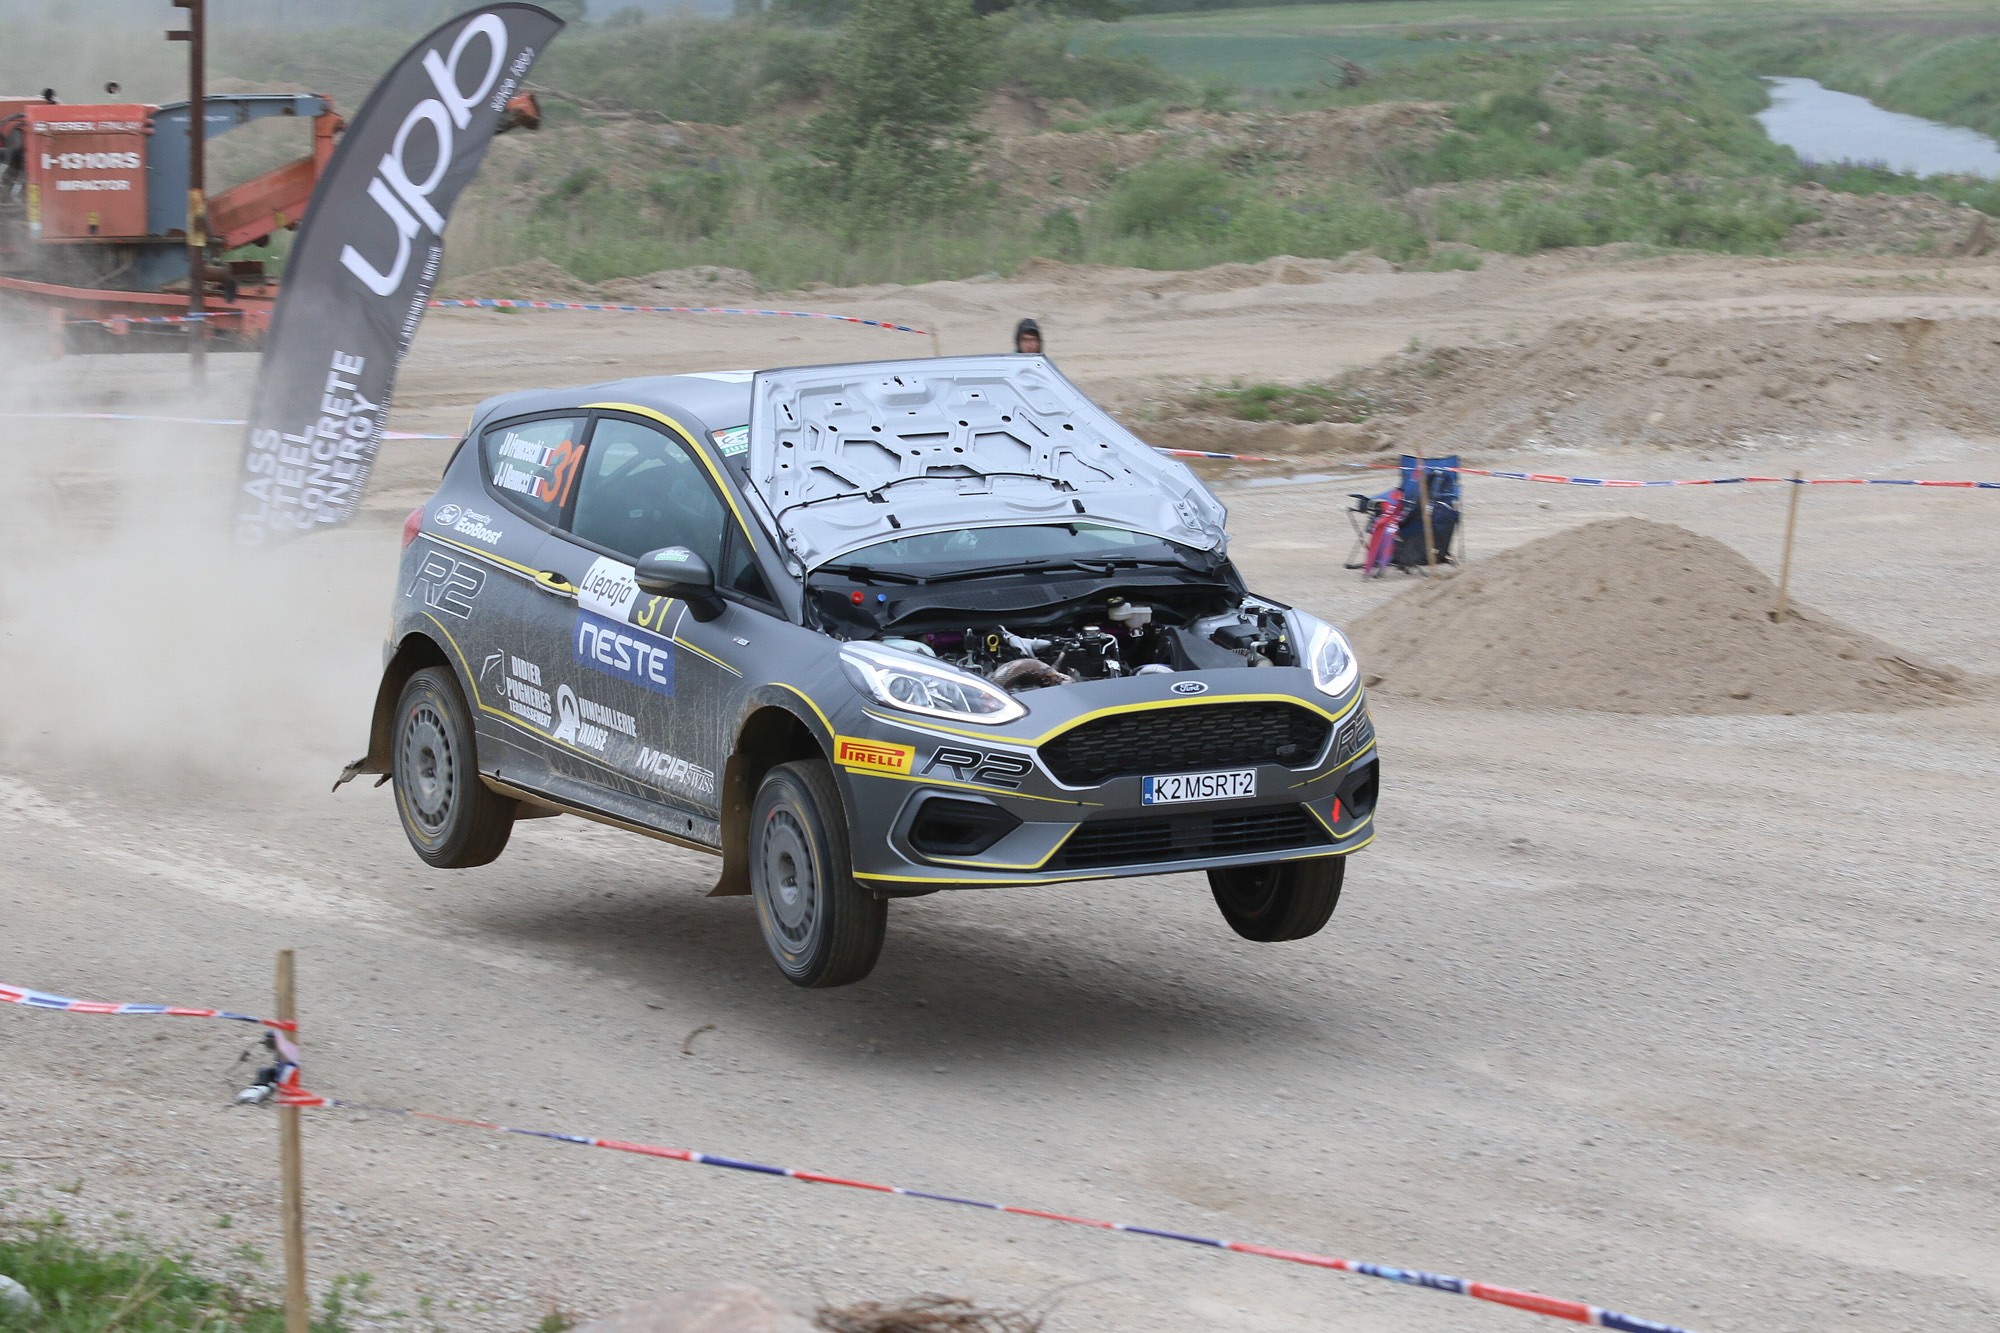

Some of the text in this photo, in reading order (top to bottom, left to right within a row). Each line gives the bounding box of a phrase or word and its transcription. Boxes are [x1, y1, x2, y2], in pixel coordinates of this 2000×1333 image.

[47, 121, 96, 131] TEREX
[56, 180, 131, 191] IMPACTOR
[296, 350, 365, 529] CONCRETE
[317, 392, 379, 523] ENERGY
[267, 425, 316, 531] STEEL
[541, 439, 586, 508] 31
[453, 516, 503, 545] EcoBoost
[406, 550, 487, 620] R2
[637, 595, 674, 632] 31
[511, 655, 542, 686] DIDIER
[579, 622, 668, 685] NESTE
[840, 742, 905, 767] PIRELLI
[919, 746, 1035, 790] R2
